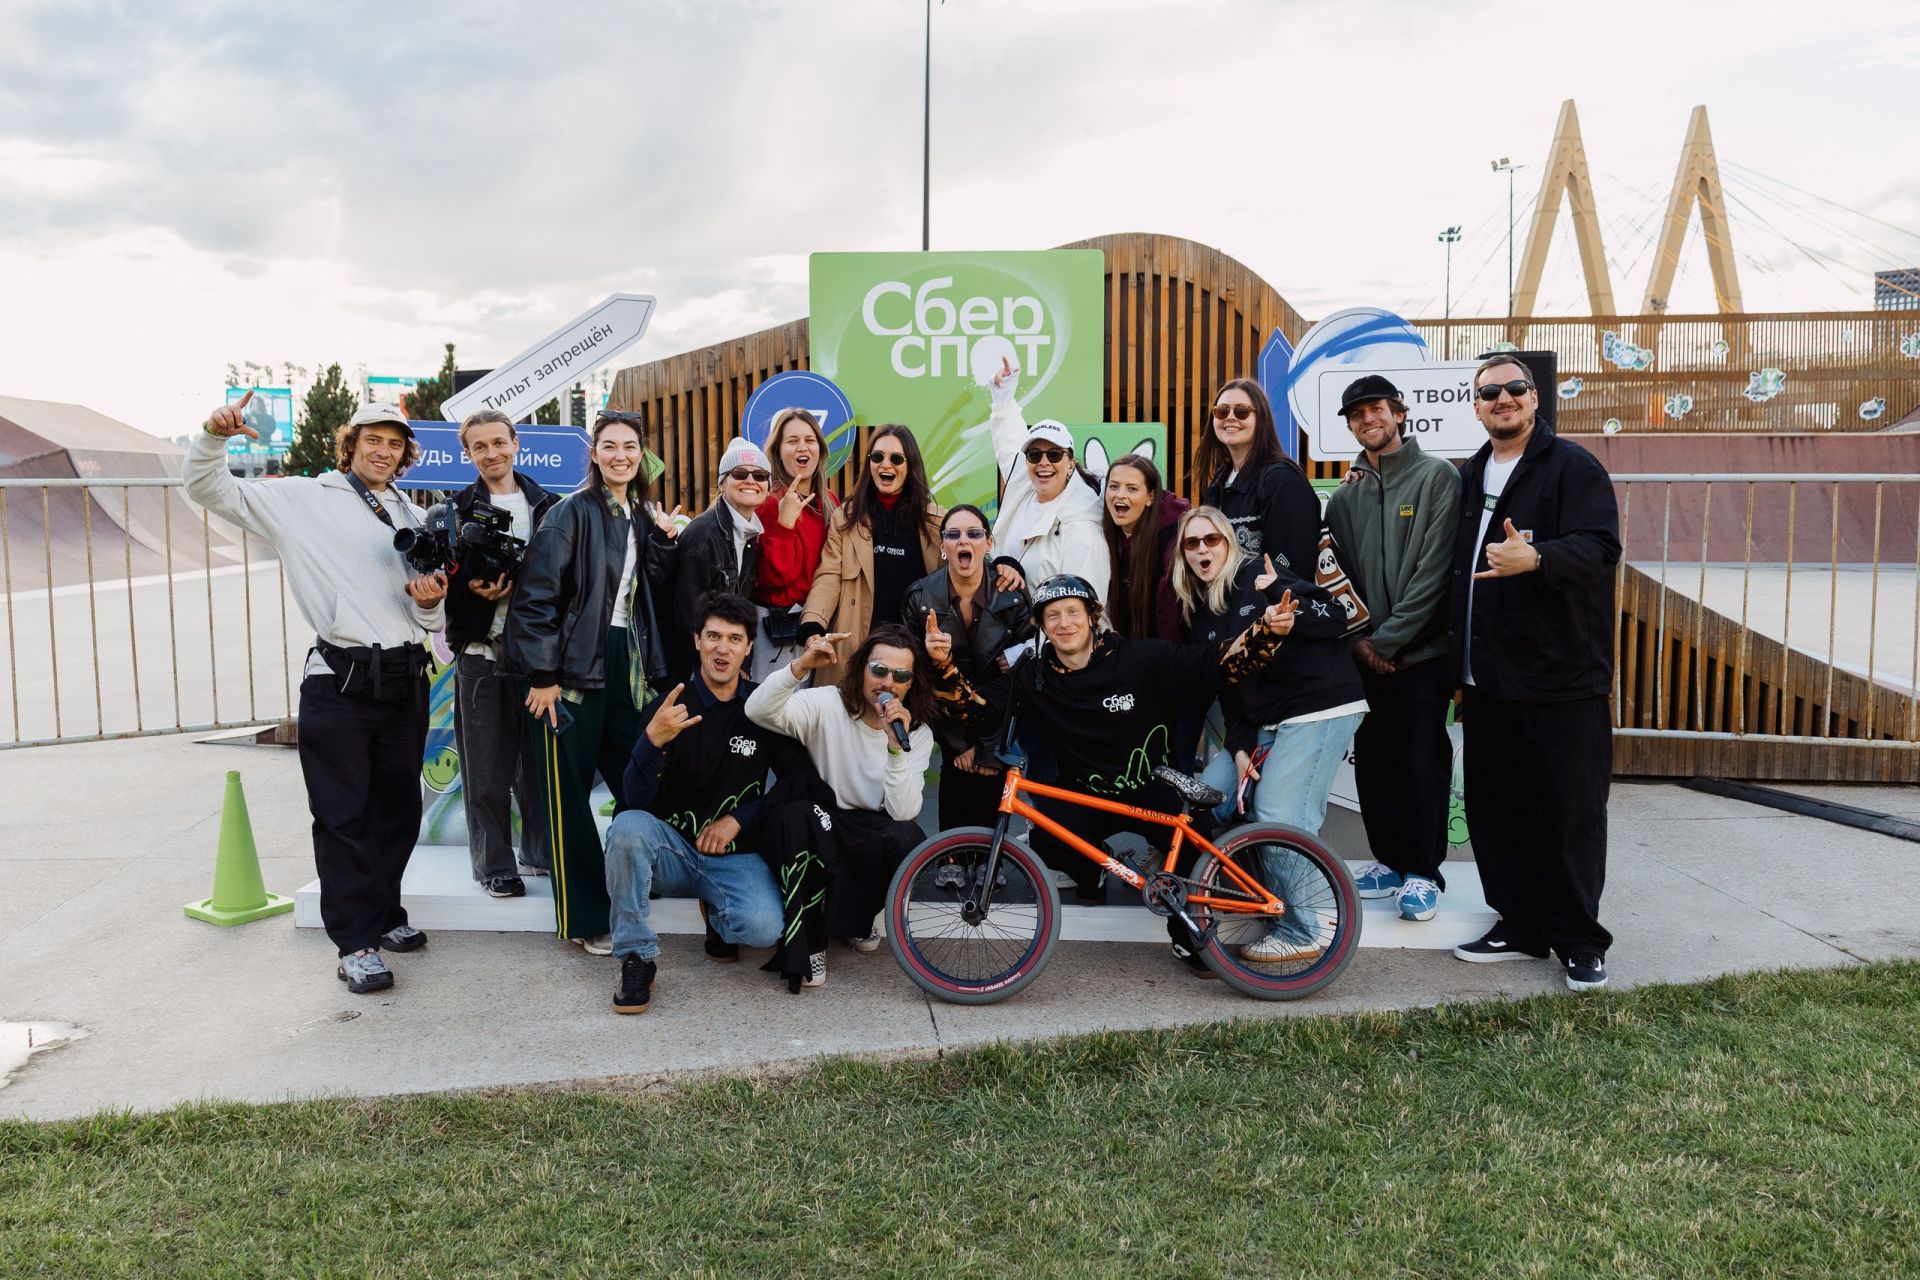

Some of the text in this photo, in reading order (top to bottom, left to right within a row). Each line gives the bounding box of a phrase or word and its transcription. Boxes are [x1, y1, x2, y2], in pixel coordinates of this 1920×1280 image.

[862, 276, 1044, 336] Сбер
[481, 323, 613, 410] Тильт запрещён
[1405, 418, 1443, 433] пот
[416, 449, 453, 467] удь
[1102, 693, 1134, 708] Сбер
[729, 735, 757, 748] Сбер
